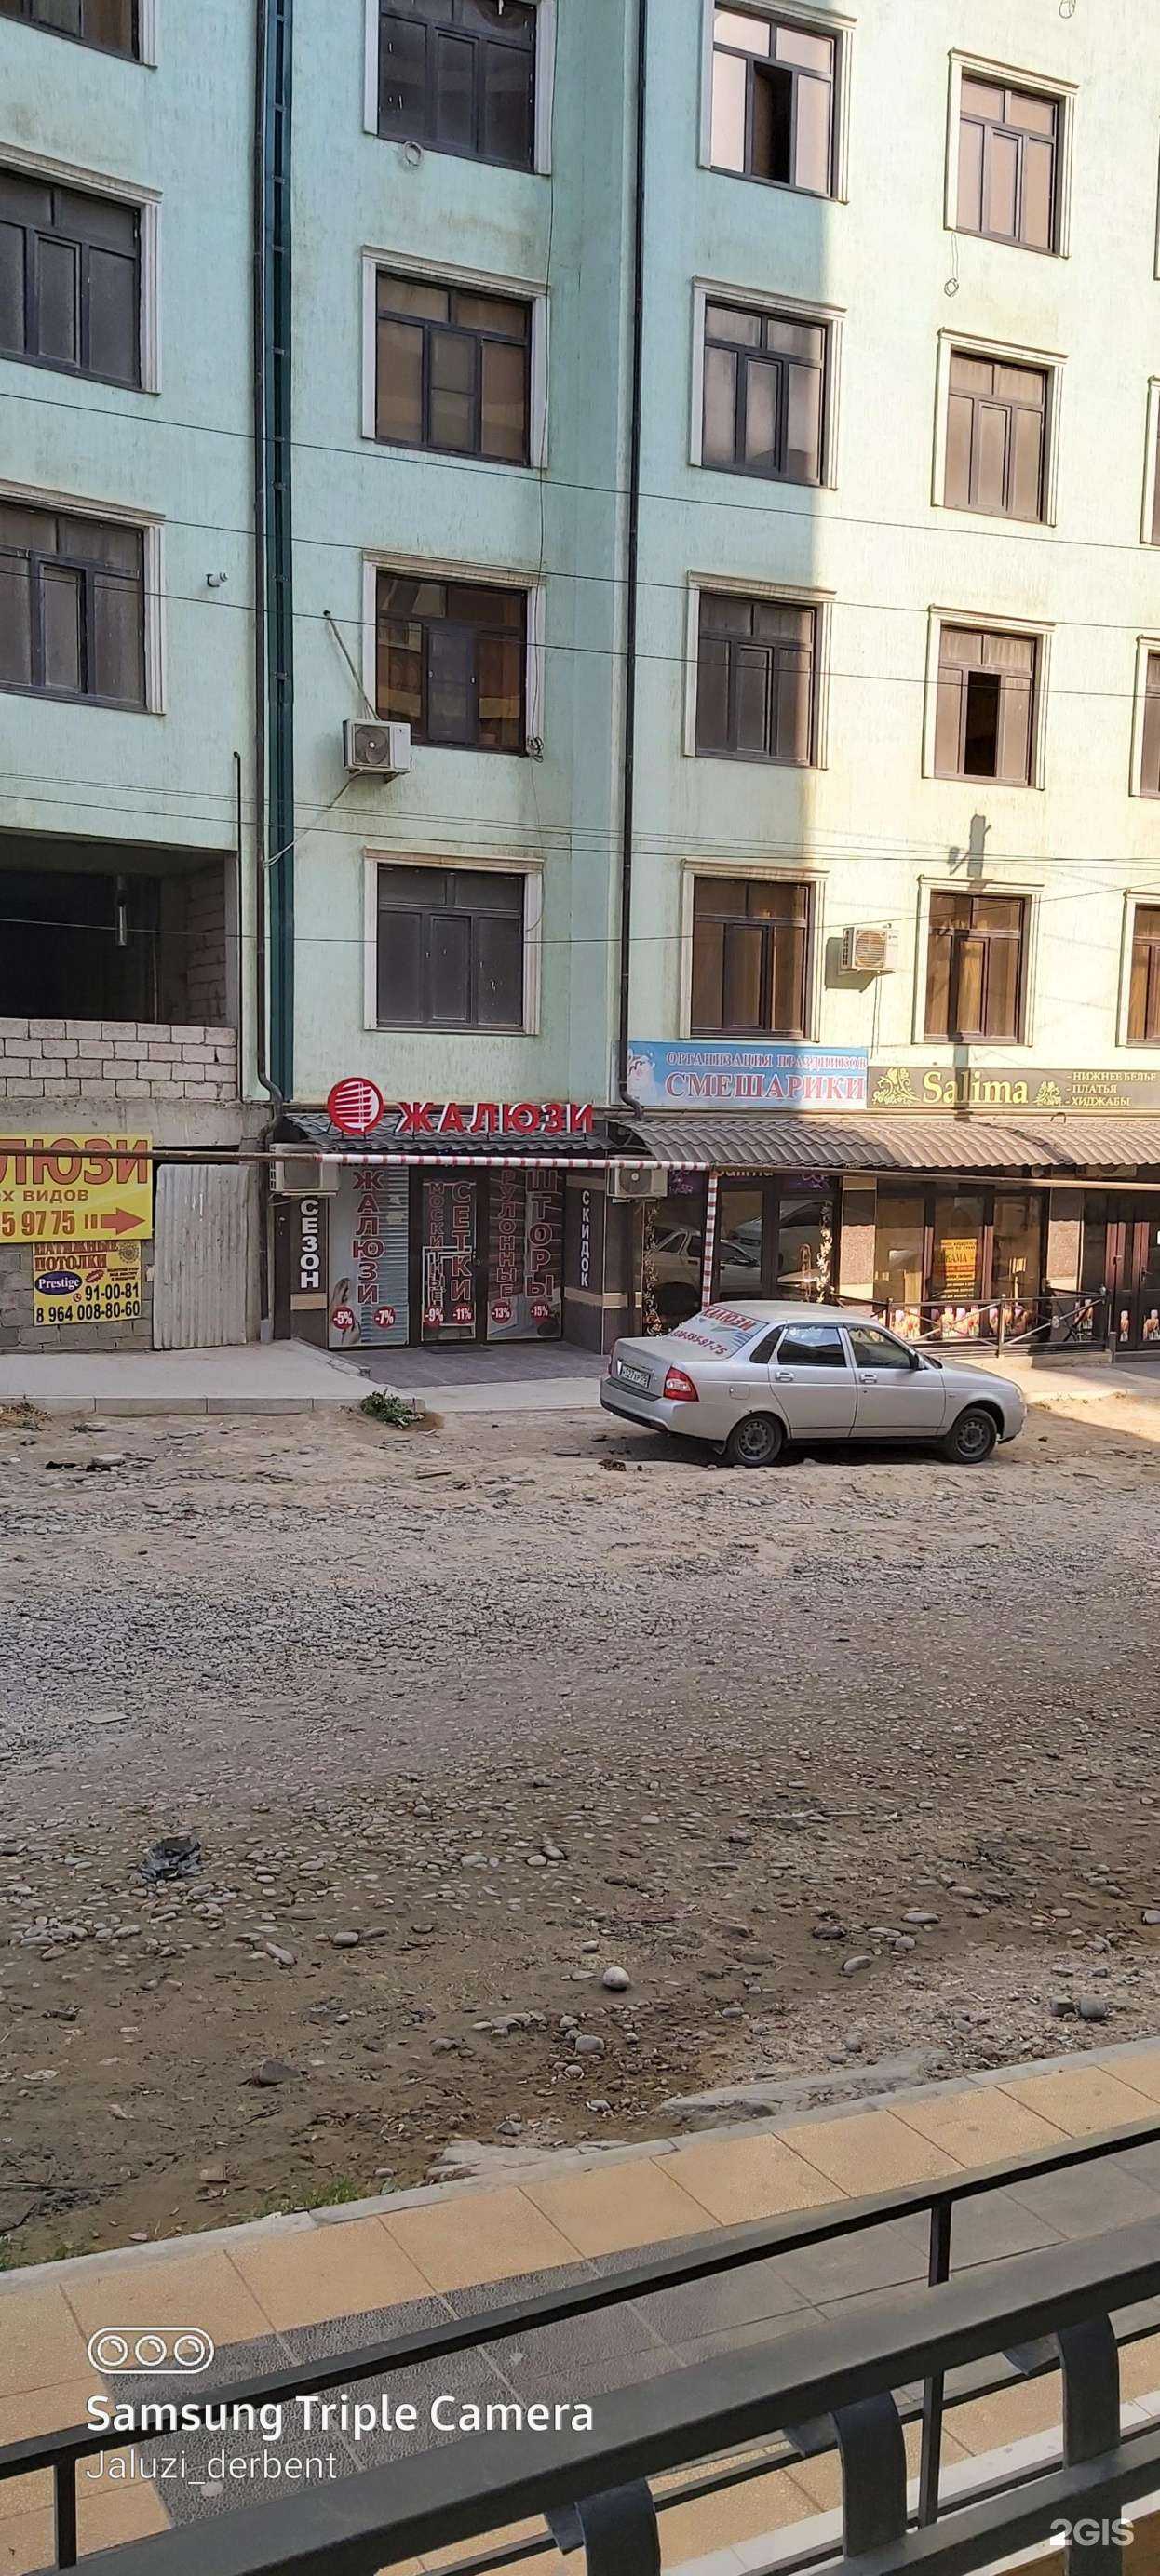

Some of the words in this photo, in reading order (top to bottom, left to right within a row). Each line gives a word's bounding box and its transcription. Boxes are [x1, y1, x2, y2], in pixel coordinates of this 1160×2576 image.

[667, 1052, 773, 1070] ОРГАНИЗАЦИЯ
[777, 1054, 867, 1069] ПРАЗДНИКОВ
[666, 1072, 866, 1100] СМЕШАРИКИ
[1124, 1072, 1157, 1081] БЕЛЬЕ
[923, 1071, 1028, 1104] Salima
[395, 1102, 594, 1133] ЖАЛЮЗИ
[22, 1211, 46, 1235] 97
[51, 1210, 74, 1234] 75
[352, 1170, 385, 1305] ЖАЛЮЗИ
[451, 1181, 472, 1301] СЕТКИ
[497, 1169, 518, 1299] РУЛОННЫЕ
[525, 1168, 558, 1298] ШТОРЫ
[581, 1190, 590, 1287] СКИДОК
[300, 1199, 319, 1288] СЕЗОН
[34, 1254, 107, 1271] ПОТОЛКИ
[39, 1278, 80, 1291] Prestige
[85, 1283, 139, 1301] 91-00-81
[37, 1308, 44, 1322] 8
[48, 1306, 73, 1322] 964
[77, 1301, 140, 1320] 008-80-60
[333, 1311, 353, 1325] -5%
[375, 1308, 394, 1324] -7%
[425, 1308, 444, 1322] -9%
[453, 1307, 472, 1321] -11%
[492, 1307, 511, 1319] -13%
[531, 1305, 549, 1317] -15%
